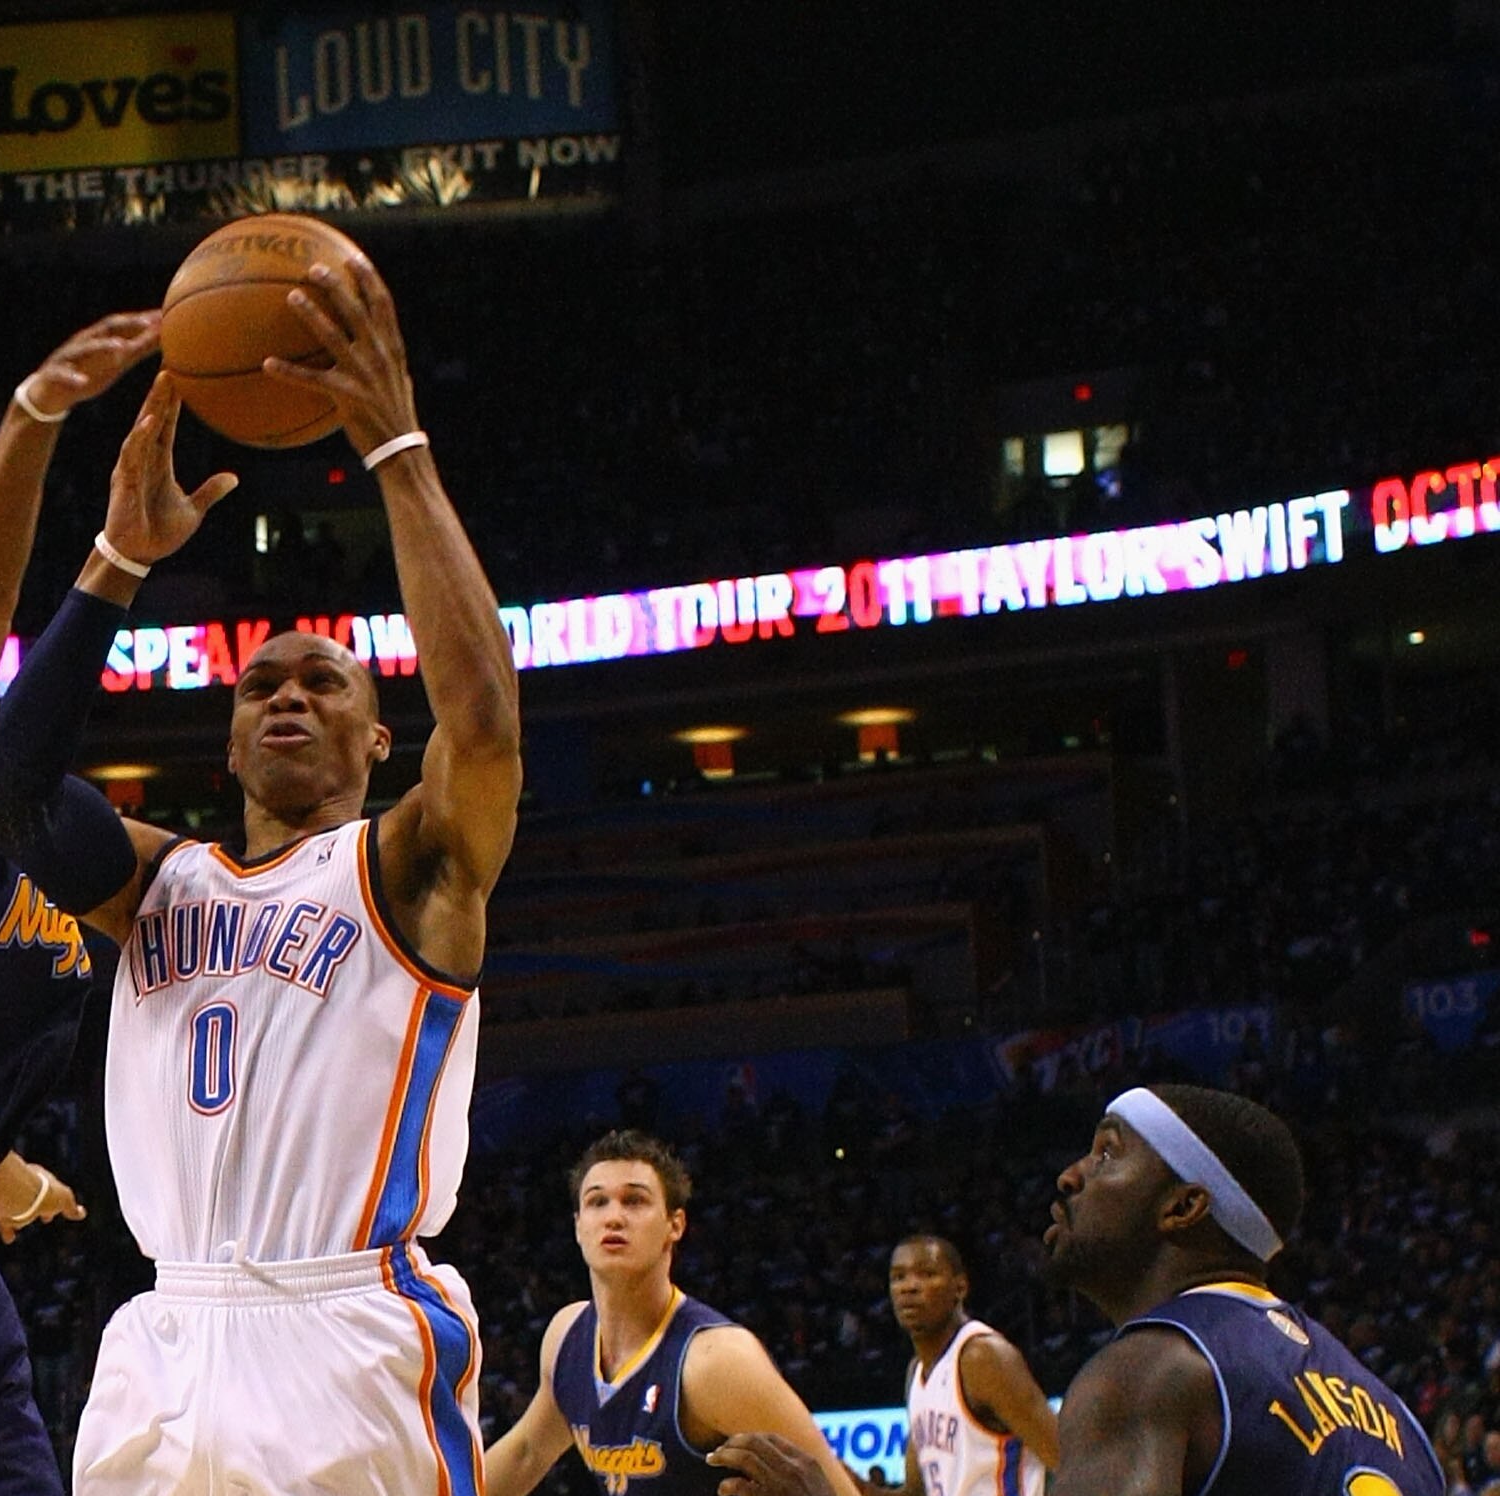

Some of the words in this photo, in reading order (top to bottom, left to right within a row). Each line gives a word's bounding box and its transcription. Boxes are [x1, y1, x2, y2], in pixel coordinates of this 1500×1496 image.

[274, 12, 432, 132] LOUD
[456, 9, 592, 108] CITY
[15, 170, 106, 200] THE
[114, 153, 329, 194] THUNDER
[402, 141, 504, 178] EXIT
[517, 134, 621, 168] NOW
[101, 618, 270, 692] SPEAK
[500, 594, 632, 670] ORLD
[648, 572, 794, 652] TOUR
[816, 557, 932, 634] 2011
[952, 527, 1167, 617] TAYLOR
[1184, 490, 1349, 588] SWIFT
[130, 900, 361, 1006] HUNDER
[187, 1000, 238, 1117] 0
